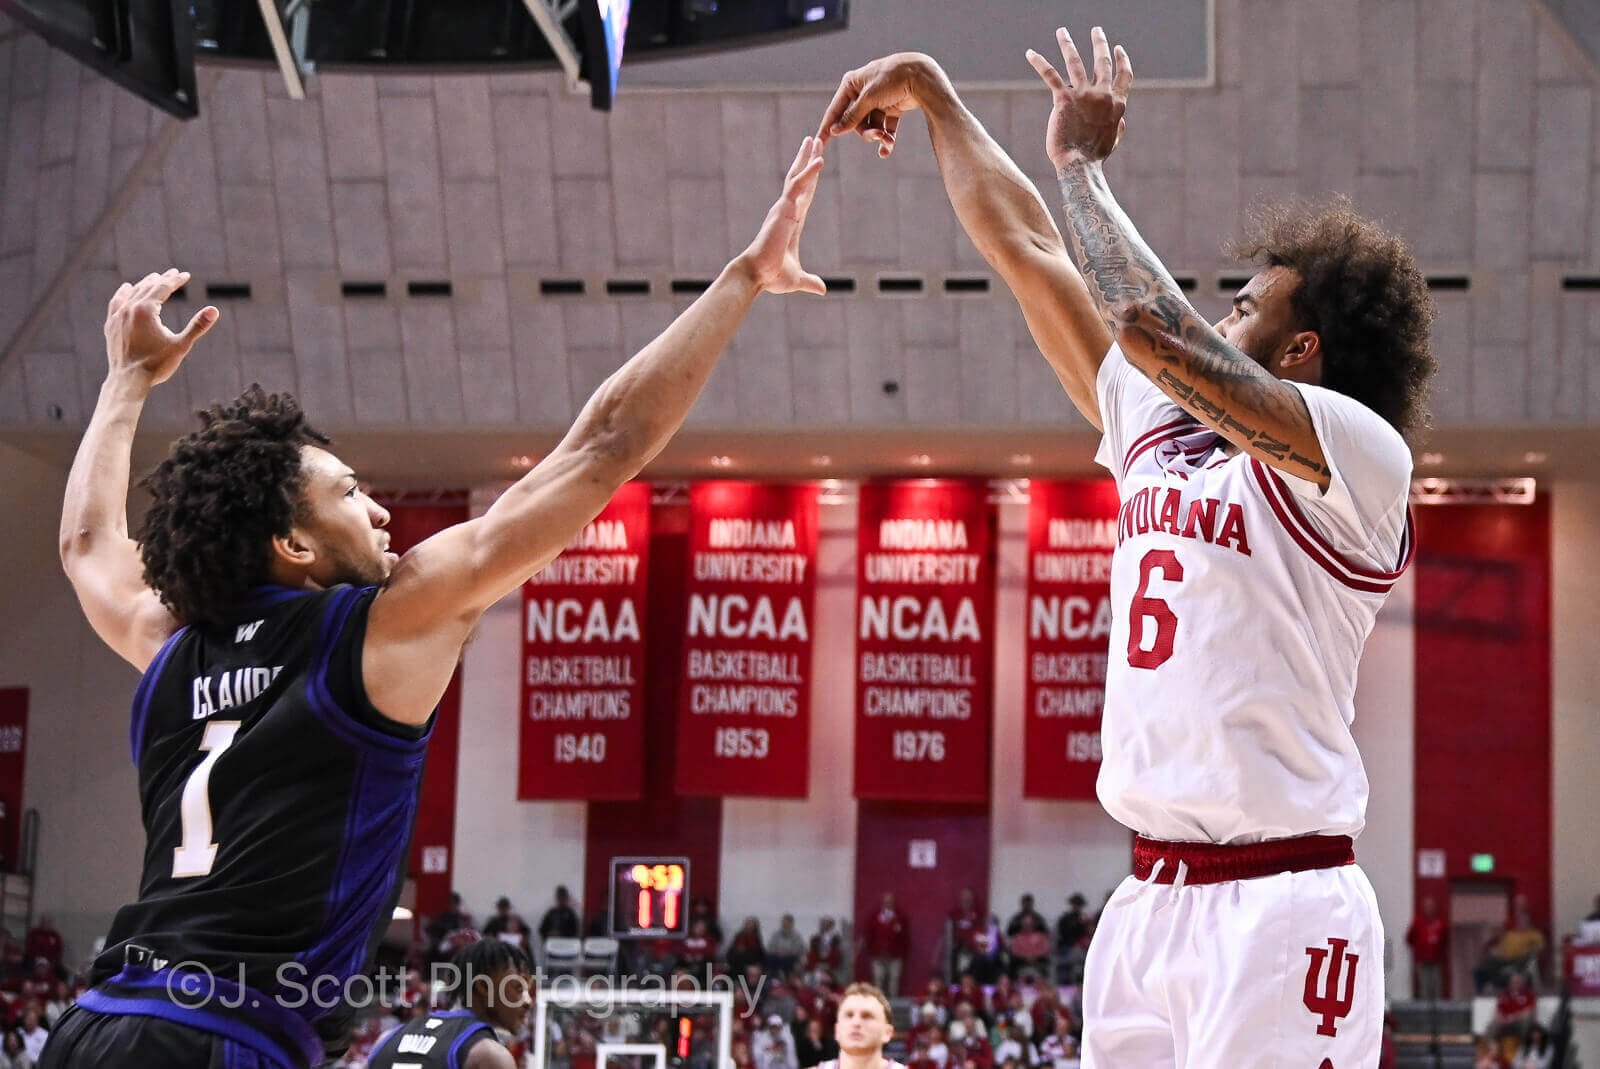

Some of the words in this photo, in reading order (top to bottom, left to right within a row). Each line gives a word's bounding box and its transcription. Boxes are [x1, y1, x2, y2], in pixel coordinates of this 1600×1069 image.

[1156, 367, 1331, 477] INLEE
[565, 519, 627, 550] IANA
[709, 518, 796, 549] INDIANA
[880, 519, 968, 549] INDIANA
[1048, 518, 1117, 548] INDIAN
[694, 552, 808, 583] UNIVERSITY
[864, 554, 980, 584] UNIVERSITY
[526, 599, 640, 642] NCAA
[687, 594, 809, 642] NCAA
[860, 595, 981, 642] NCAA
[1030, 595, 1112, 641] NCA
[1127, 549, 1184, 670] 6
[234, 619, 265, 644] W
[527, 656, 636, 686] BASKETBALL
[687, 649, 802, 683] BASKETBALL
[862, 652, 975, 685] BASKETBALL
[1031, 652, 1108, 684] BASKET
[192, 665, 284, 720] CLAUD
[529, 690, 631, 721] CHAMPIONS
[691, 685, 797, 717] CHAMPIONS
[864, 688, 971, 719] CHAMPIONS
[1035, 688, 1104, 718] CHAMP
[554, 733, 606, 763] 1940
[714, 727, 769, 759] 1953
[893, 730, 945, 762] 1976
[1066, 731, 1102, 762] 198
[171, 720, 241, 878] 1
[638, 889, 679, 929] 11
